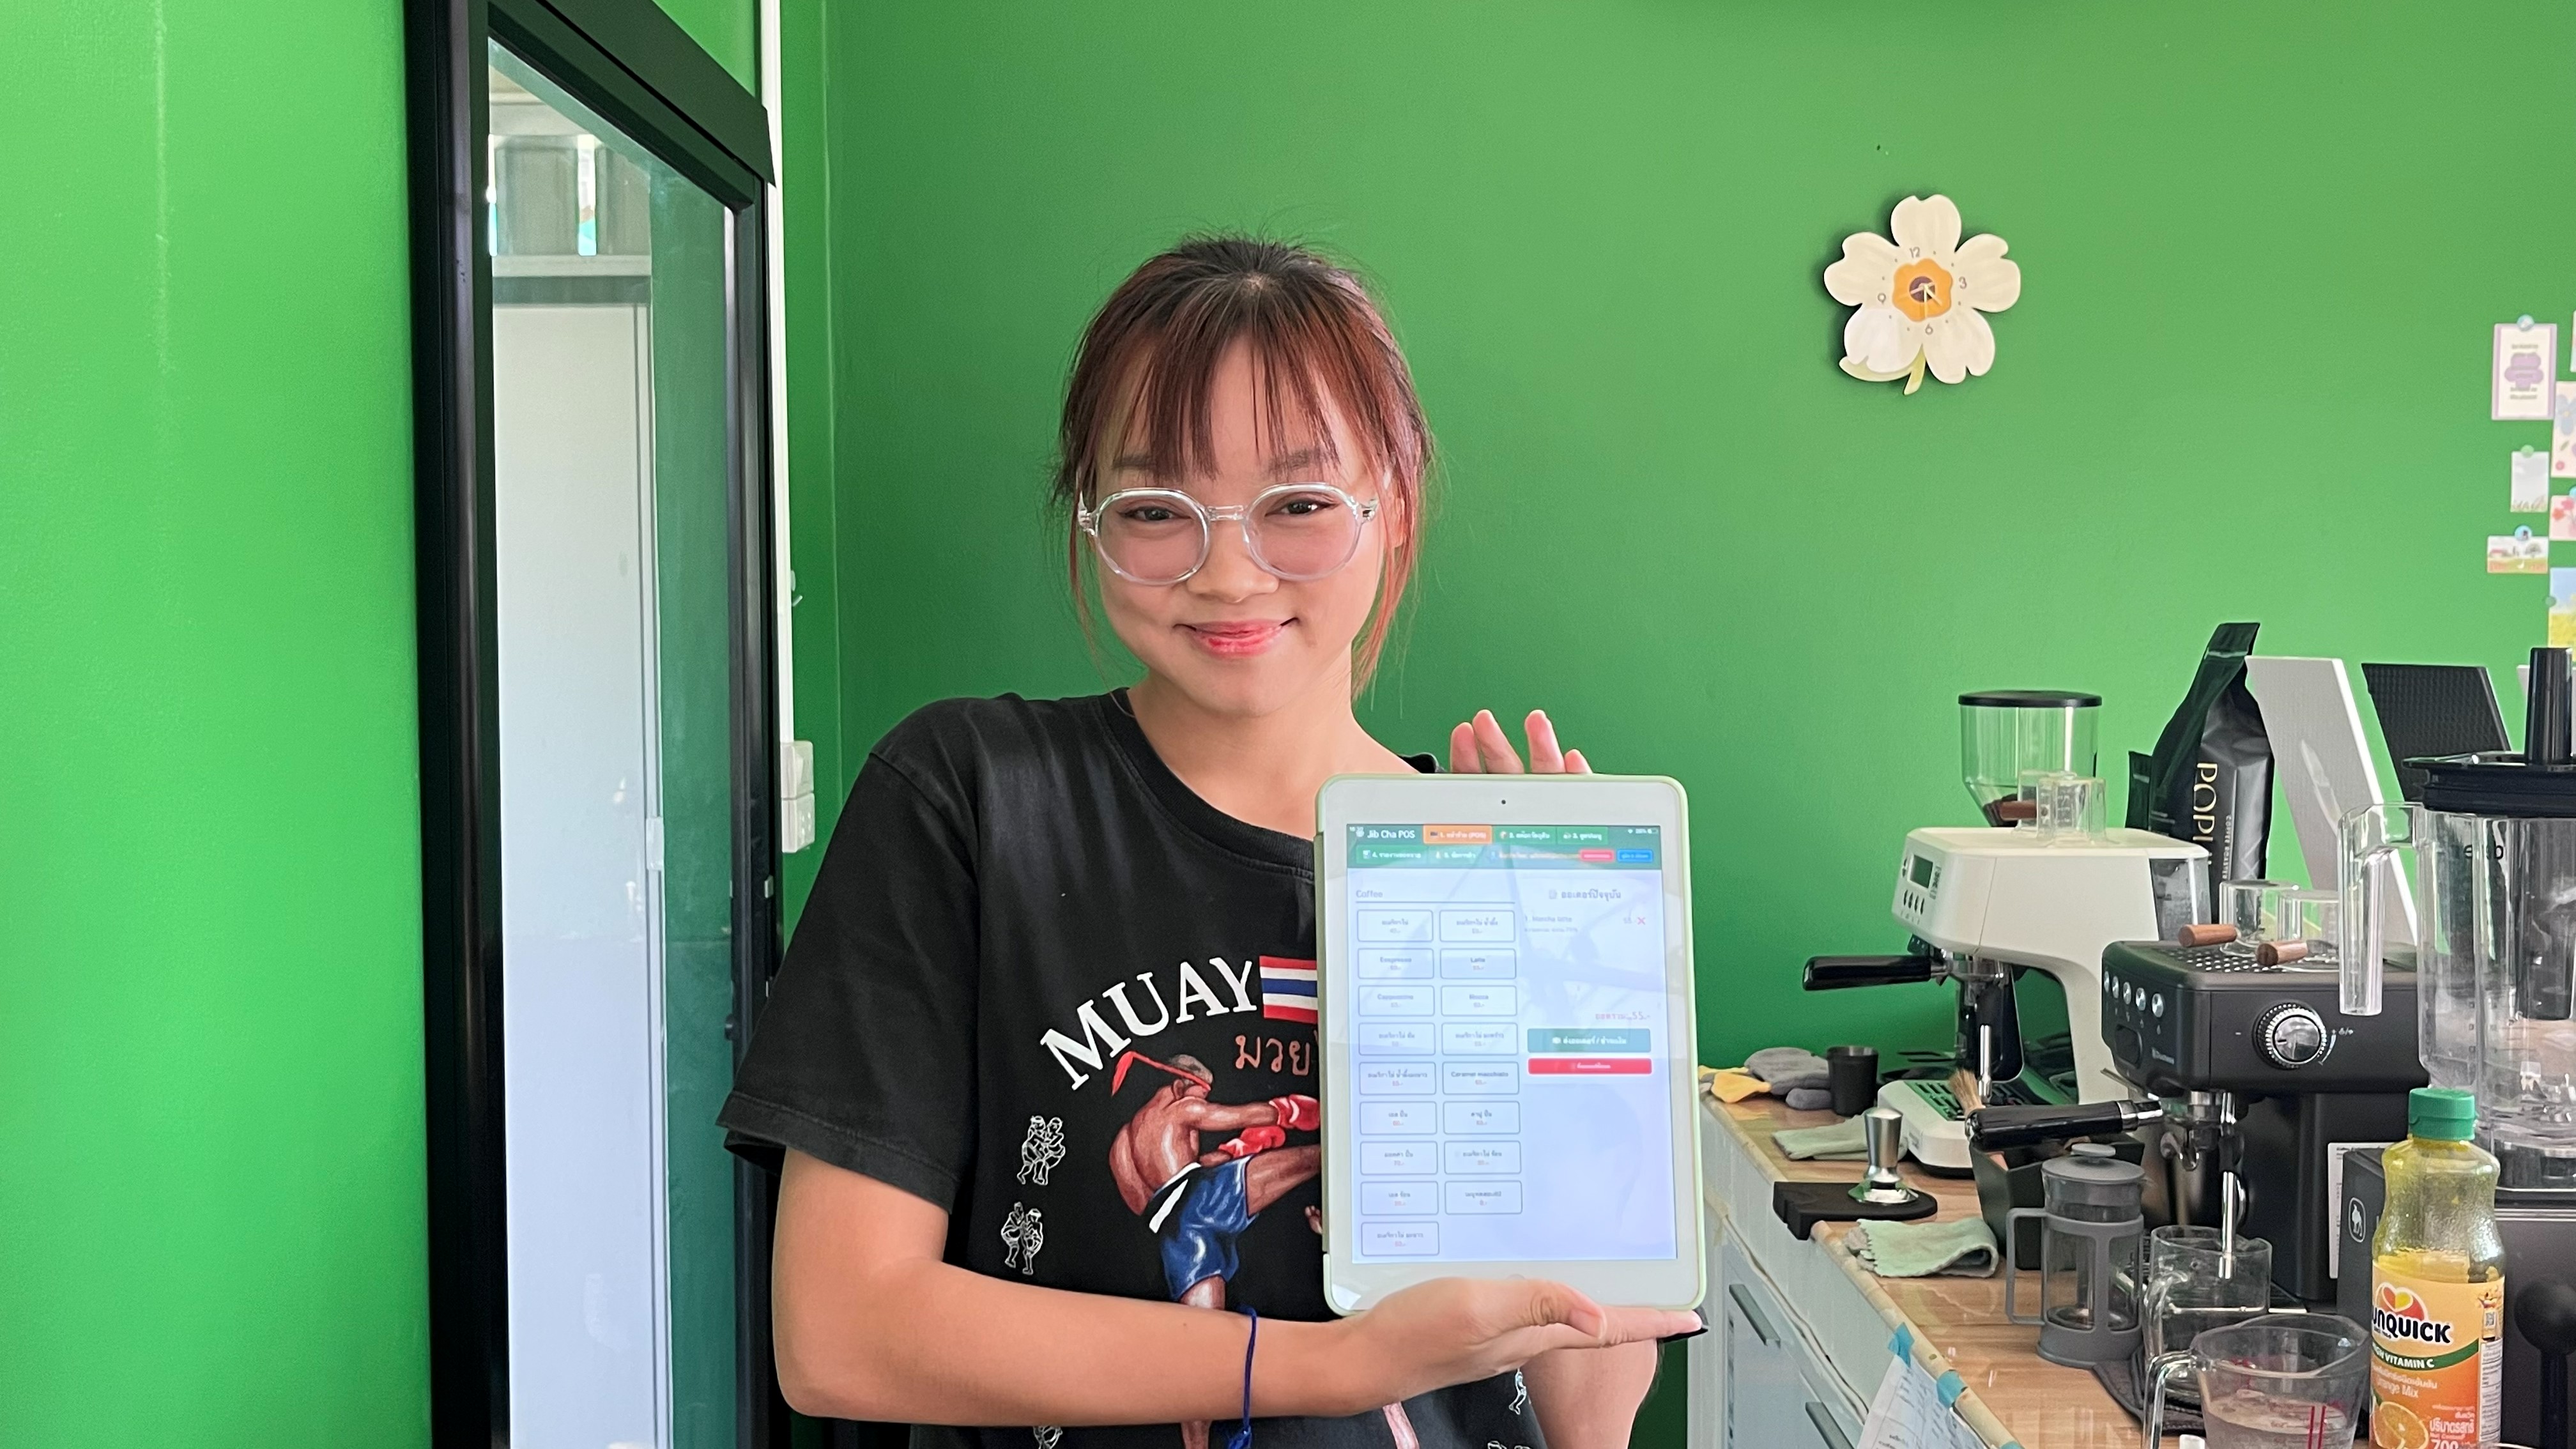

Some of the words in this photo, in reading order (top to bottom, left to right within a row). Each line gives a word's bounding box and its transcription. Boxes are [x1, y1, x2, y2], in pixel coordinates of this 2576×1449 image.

[1909, 247, 1920, 258] 12
[1958, 276, 1967, 289] 3
[1877, 293, 1886, 305] 9
[1924, 324, 1933, 335] 6
[2193, 763, 2218, 864] POPI
[1367, 830, 1379, 838] Jib
[1381, 830, 1397, 838] Cha
[1398, 830, 1415, 838] POS
[1356, 890, 1383, 898] Coffee
[1040, 957, 1257, 1091] MUAY
[1234, 1030, 1318, 1077] มวย
[2373, 1308, 2451, 1344] UNQUICK
[2384, 1354, 2425, 1368] VITAMIN
[2426, 1358, 2435, 1368] C
[2402, 1384, 2419, 1399] Mix
